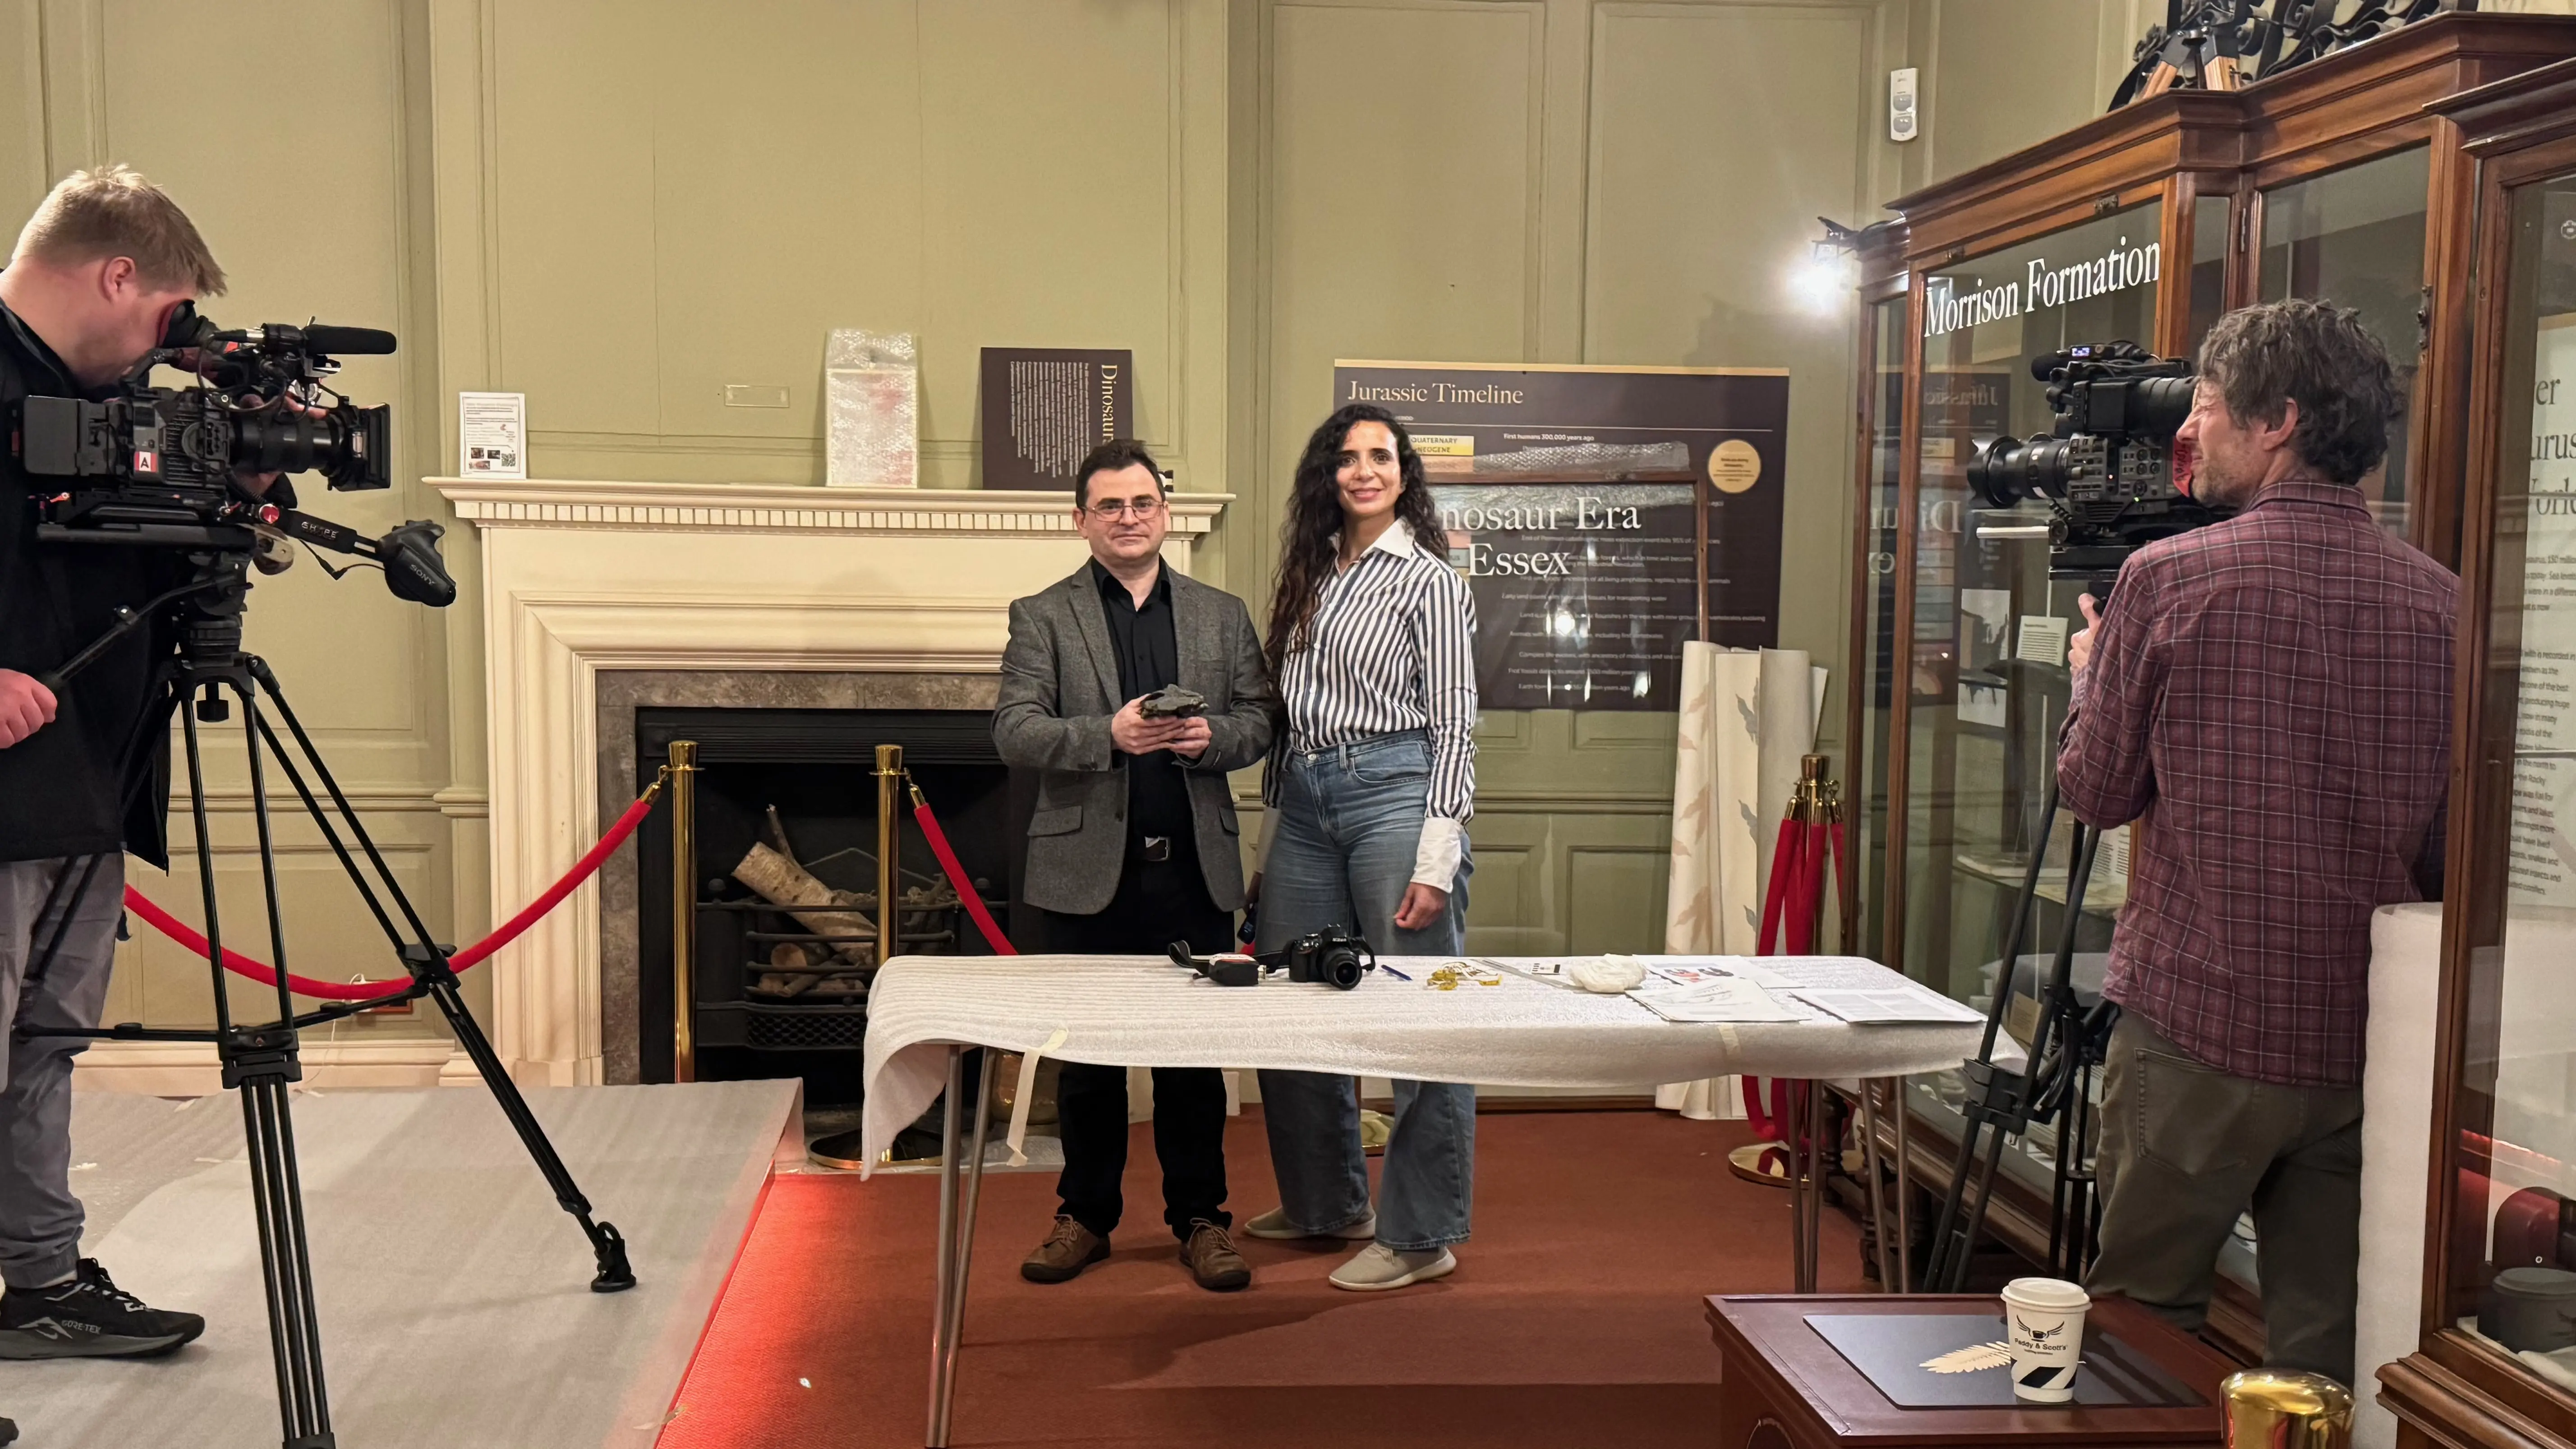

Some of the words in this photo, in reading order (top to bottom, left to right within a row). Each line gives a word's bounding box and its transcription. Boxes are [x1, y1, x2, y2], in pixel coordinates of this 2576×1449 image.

[1924, 278, 2018, 338] Morrison
[2025, 236, 2161, 313] Formation
[1348, 381, 1428, 401] Jurassic
[1432, 383, 1523, 404] Timeline
[140, 457, 149, 468] A
[1441, 505, 1564, 530] nosaur
[1575, 497, 1642, 530] Era
[1467, 543, 1572, 576] Essex
[409, 564, 436, 586] SONY
[61, 1319, 101, 1334] GORE-TEX
[2014, 1338, 2033, 1349] Paddy
